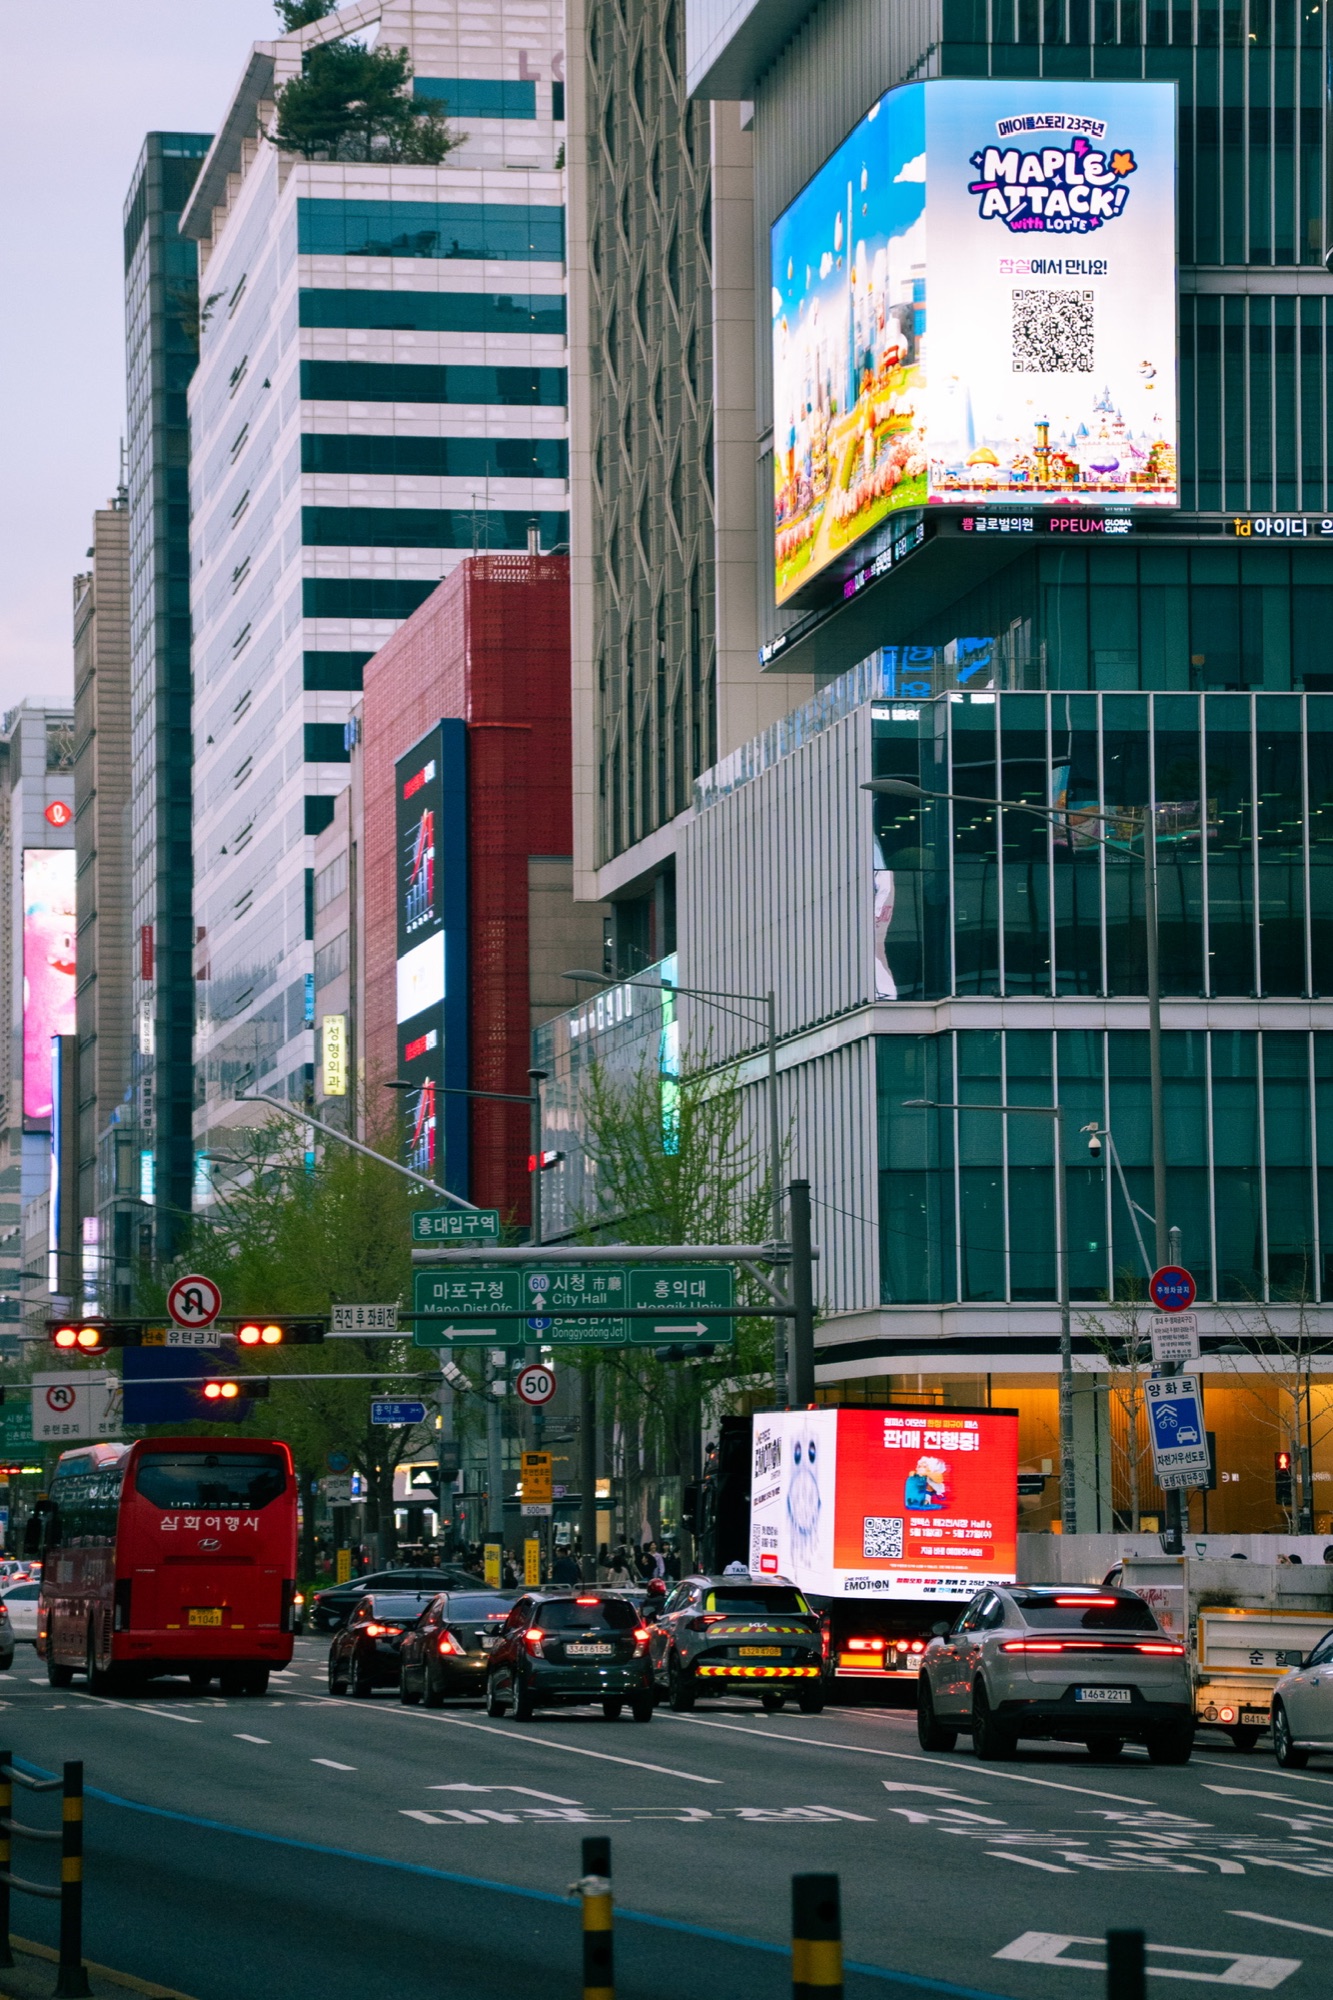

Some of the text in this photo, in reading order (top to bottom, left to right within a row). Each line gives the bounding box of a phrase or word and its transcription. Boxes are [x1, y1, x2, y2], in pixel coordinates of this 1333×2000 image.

[998, 114, 1105, 137] 메이플스토리 23주년
[984, 148, 1116, 186] MAPLE
[982, 185, 1126, 218] ATTACK!
[1010, 217, 1088, 231] with LOTTE
[999, 259, 1108, 275] 잠실에서 만나요!
[1050, 518, 1104, 532] PPEUM
[1104, 518, 1132, 526] GLOBAL
[1104, 526, 1128, 534] CLINIC
[1232, 517, 1251, 537] id
[1254, 517, 1307, 537] 아이디
[326, 1026, 341, 1089] 성형외과
[417, 1215, 494, 1235] 홍대입구역
[433, 1281, 503, 1300] 마포구청
[532, 1277, 547, 1291] 60
[553, 1274, 585, 1291] 시청
[653, 1280, 706, 1298] 홍익대
[1157, 1286, 1190, 1295] 주정차금지
[552, 1293, 607, 1307] City Hall
[335, 1307, 395, 1328] 직진 후 좌회전
[169, 1332, 217, 1345] 유턴금지
[552, 1326, 623, 1340] Donggyodong Jct
[524, 1376, 549, 1395] 50
[1148, 1380, 1196, 1398] 양화로
[375, 1405, 401, 1415] 홍익로
[43, 1423, 80, 1435] 유턴금지
[883, 1430, 980, 1452] 판매 진행중!
[1157, 1450, 1206, 1467] 자전거우선도로
[1163, 1472, 1206, 1488] 보행자횡단주의
[527, 1506, 547, 1515] 500m
[160, 1515, 259, 1532] 삼화여행사
[844, 1579, 890, 1592] EMOTION
[1107, 1690, 1128, 1700] 2211
